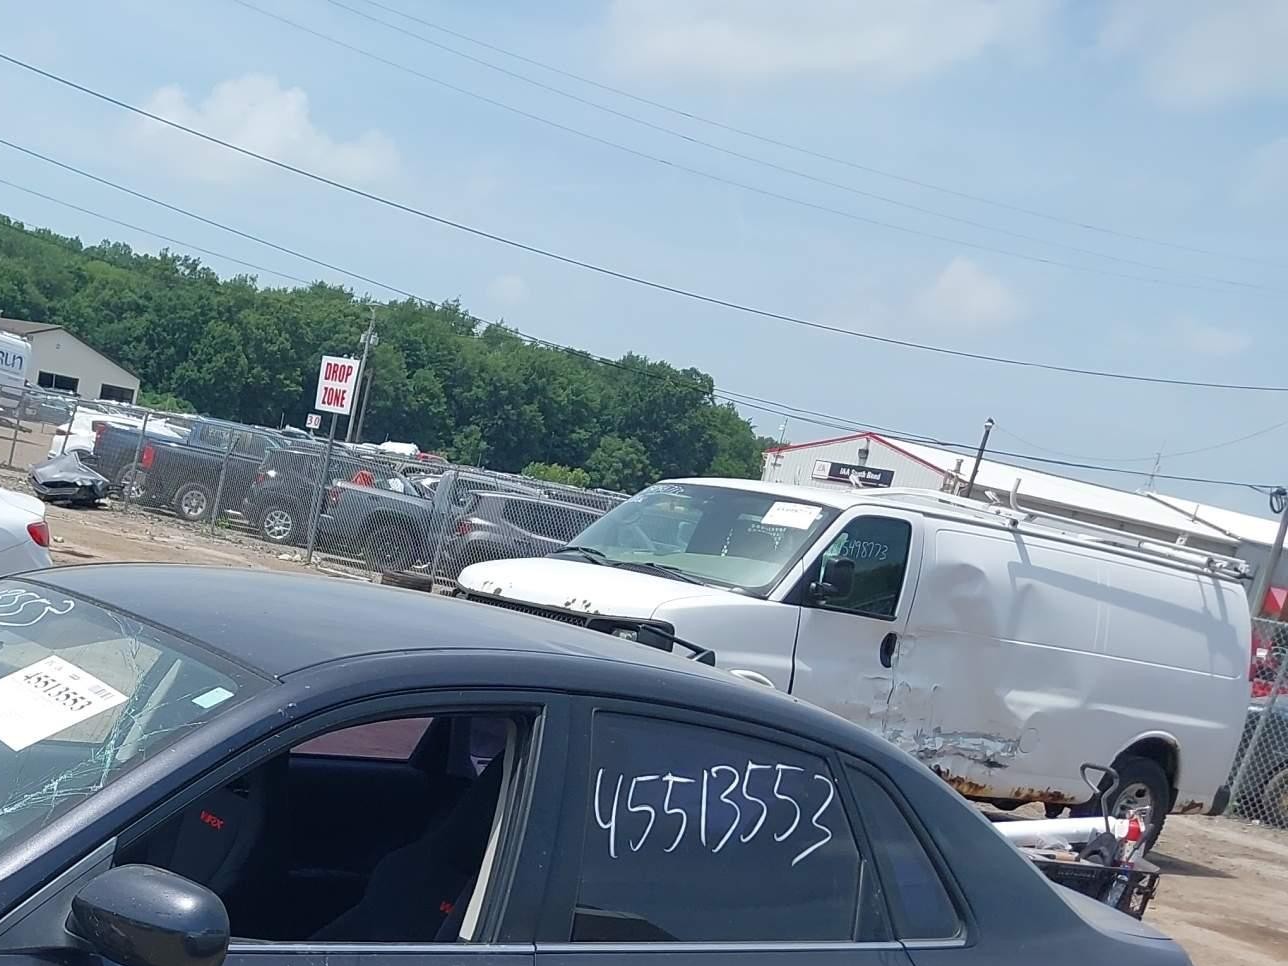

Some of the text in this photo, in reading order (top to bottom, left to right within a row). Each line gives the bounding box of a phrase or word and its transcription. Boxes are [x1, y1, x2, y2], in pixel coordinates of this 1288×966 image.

[324, 362, 354, 384] DROP
[321, 387, 347, 408] ZONE
[307, 415, 321, 427] 30
[23, 672, 93, 712] 45513553
[594, 760, 834, 867] 45513553
